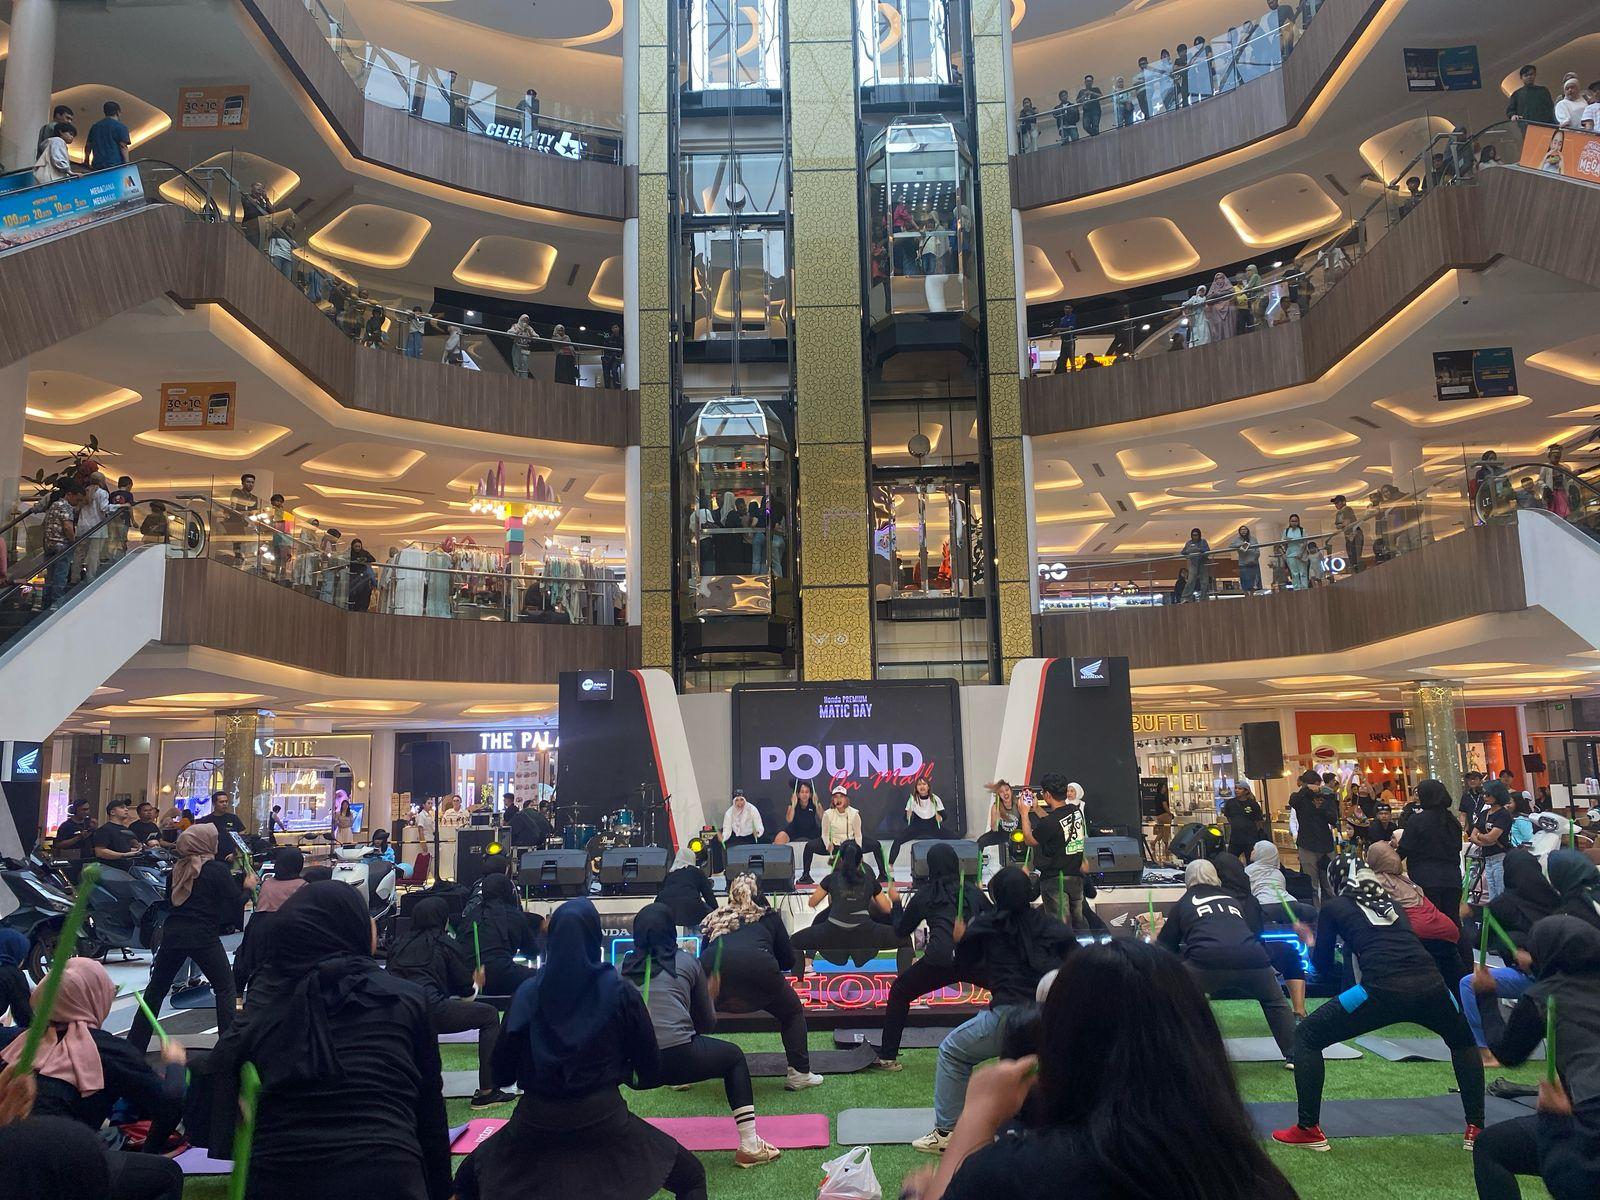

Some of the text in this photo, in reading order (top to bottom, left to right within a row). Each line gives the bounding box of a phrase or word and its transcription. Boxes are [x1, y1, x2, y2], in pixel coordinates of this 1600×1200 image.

[823, 695, 868, 704] Honda PREMIUM
[818, 703, 873, 719] MATIC DAY
[480, 731, 514, 751] THE
[761, 743, 923, 780] POUND
[1196, 903, 1244, 918] AIR
